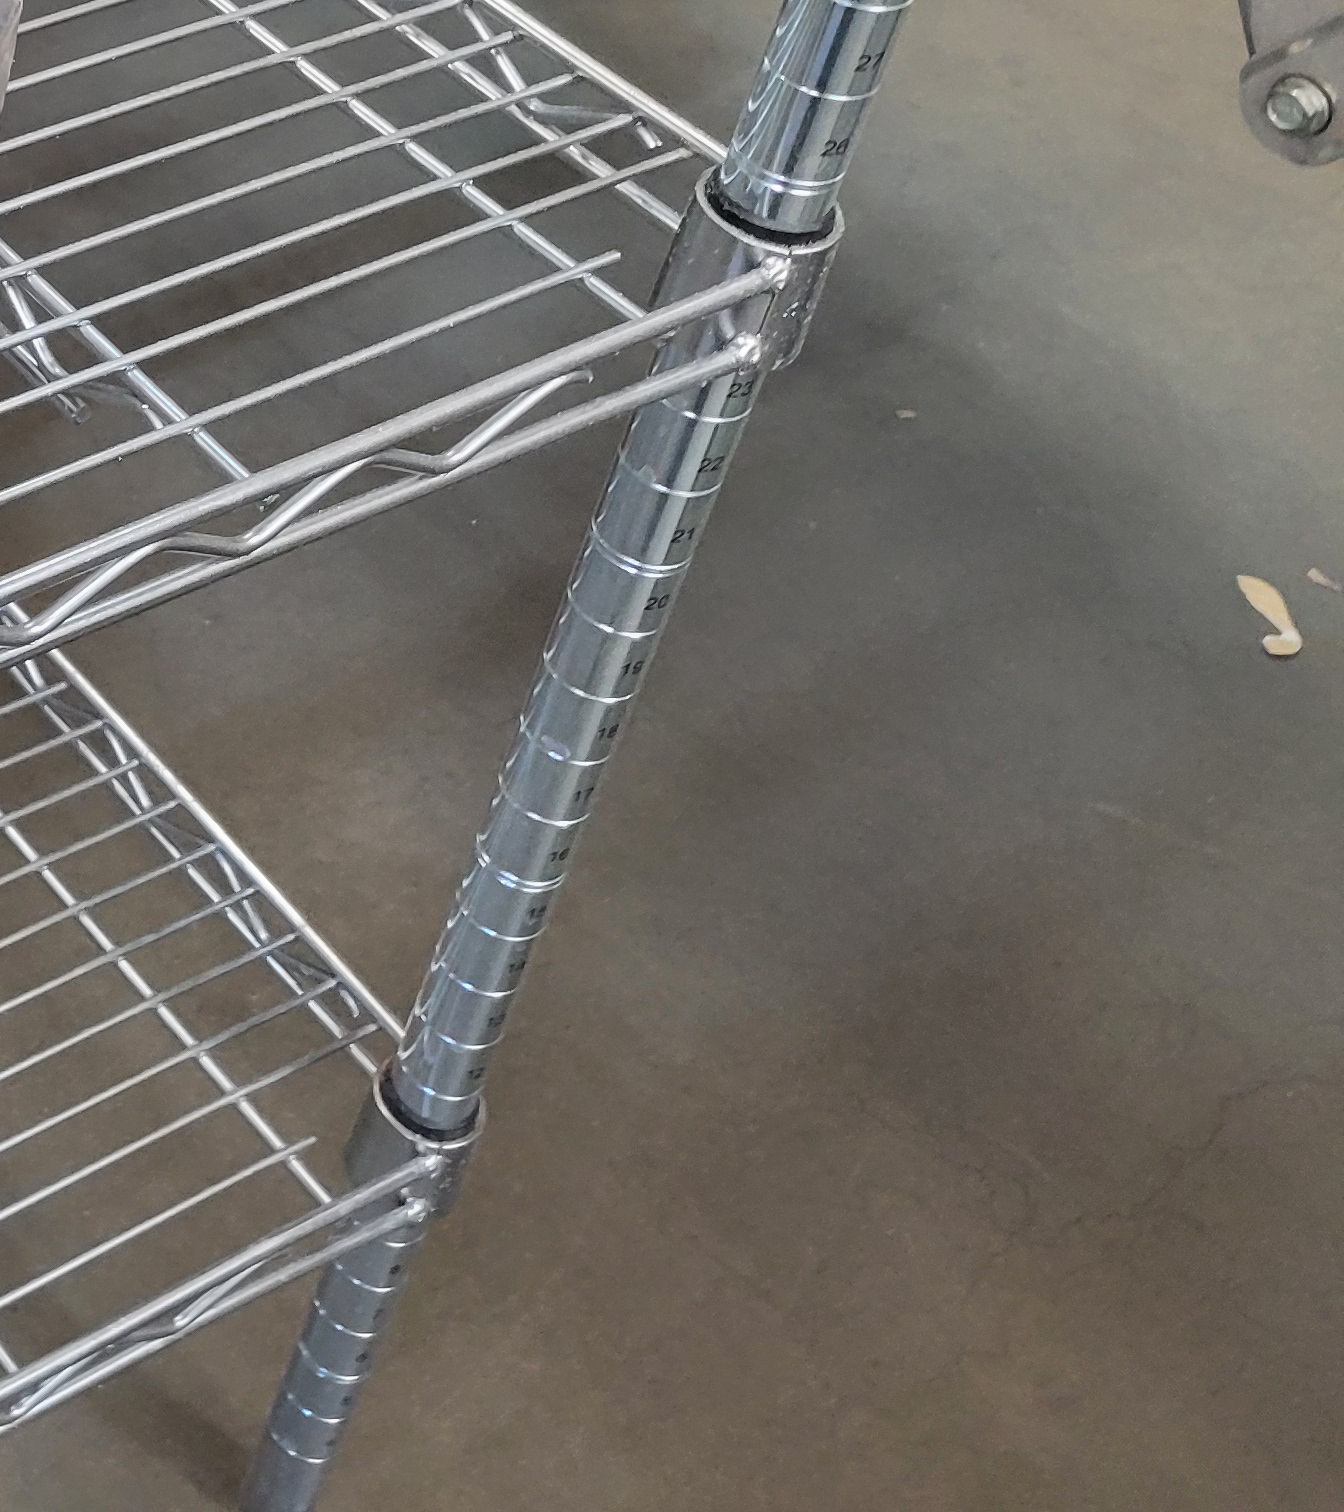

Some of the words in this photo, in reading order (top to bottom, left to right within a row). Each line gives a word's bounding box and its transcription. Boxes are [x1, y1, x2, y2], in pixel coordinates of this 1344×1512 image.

[852, 50, 887, 73] 27
[819, 137, 850, 158] 26
[726, 382, 754, 399] 23
[698, 455, 726, 474] 22
[670, 526, 696, 544] 21
[643, 593, 671, 611] 20
[621, 660, 645, 676] 19
[598, 723, 620, 740] 18
[573, 786, 596, 803] 17
[550, 847, 571, 863] 16
